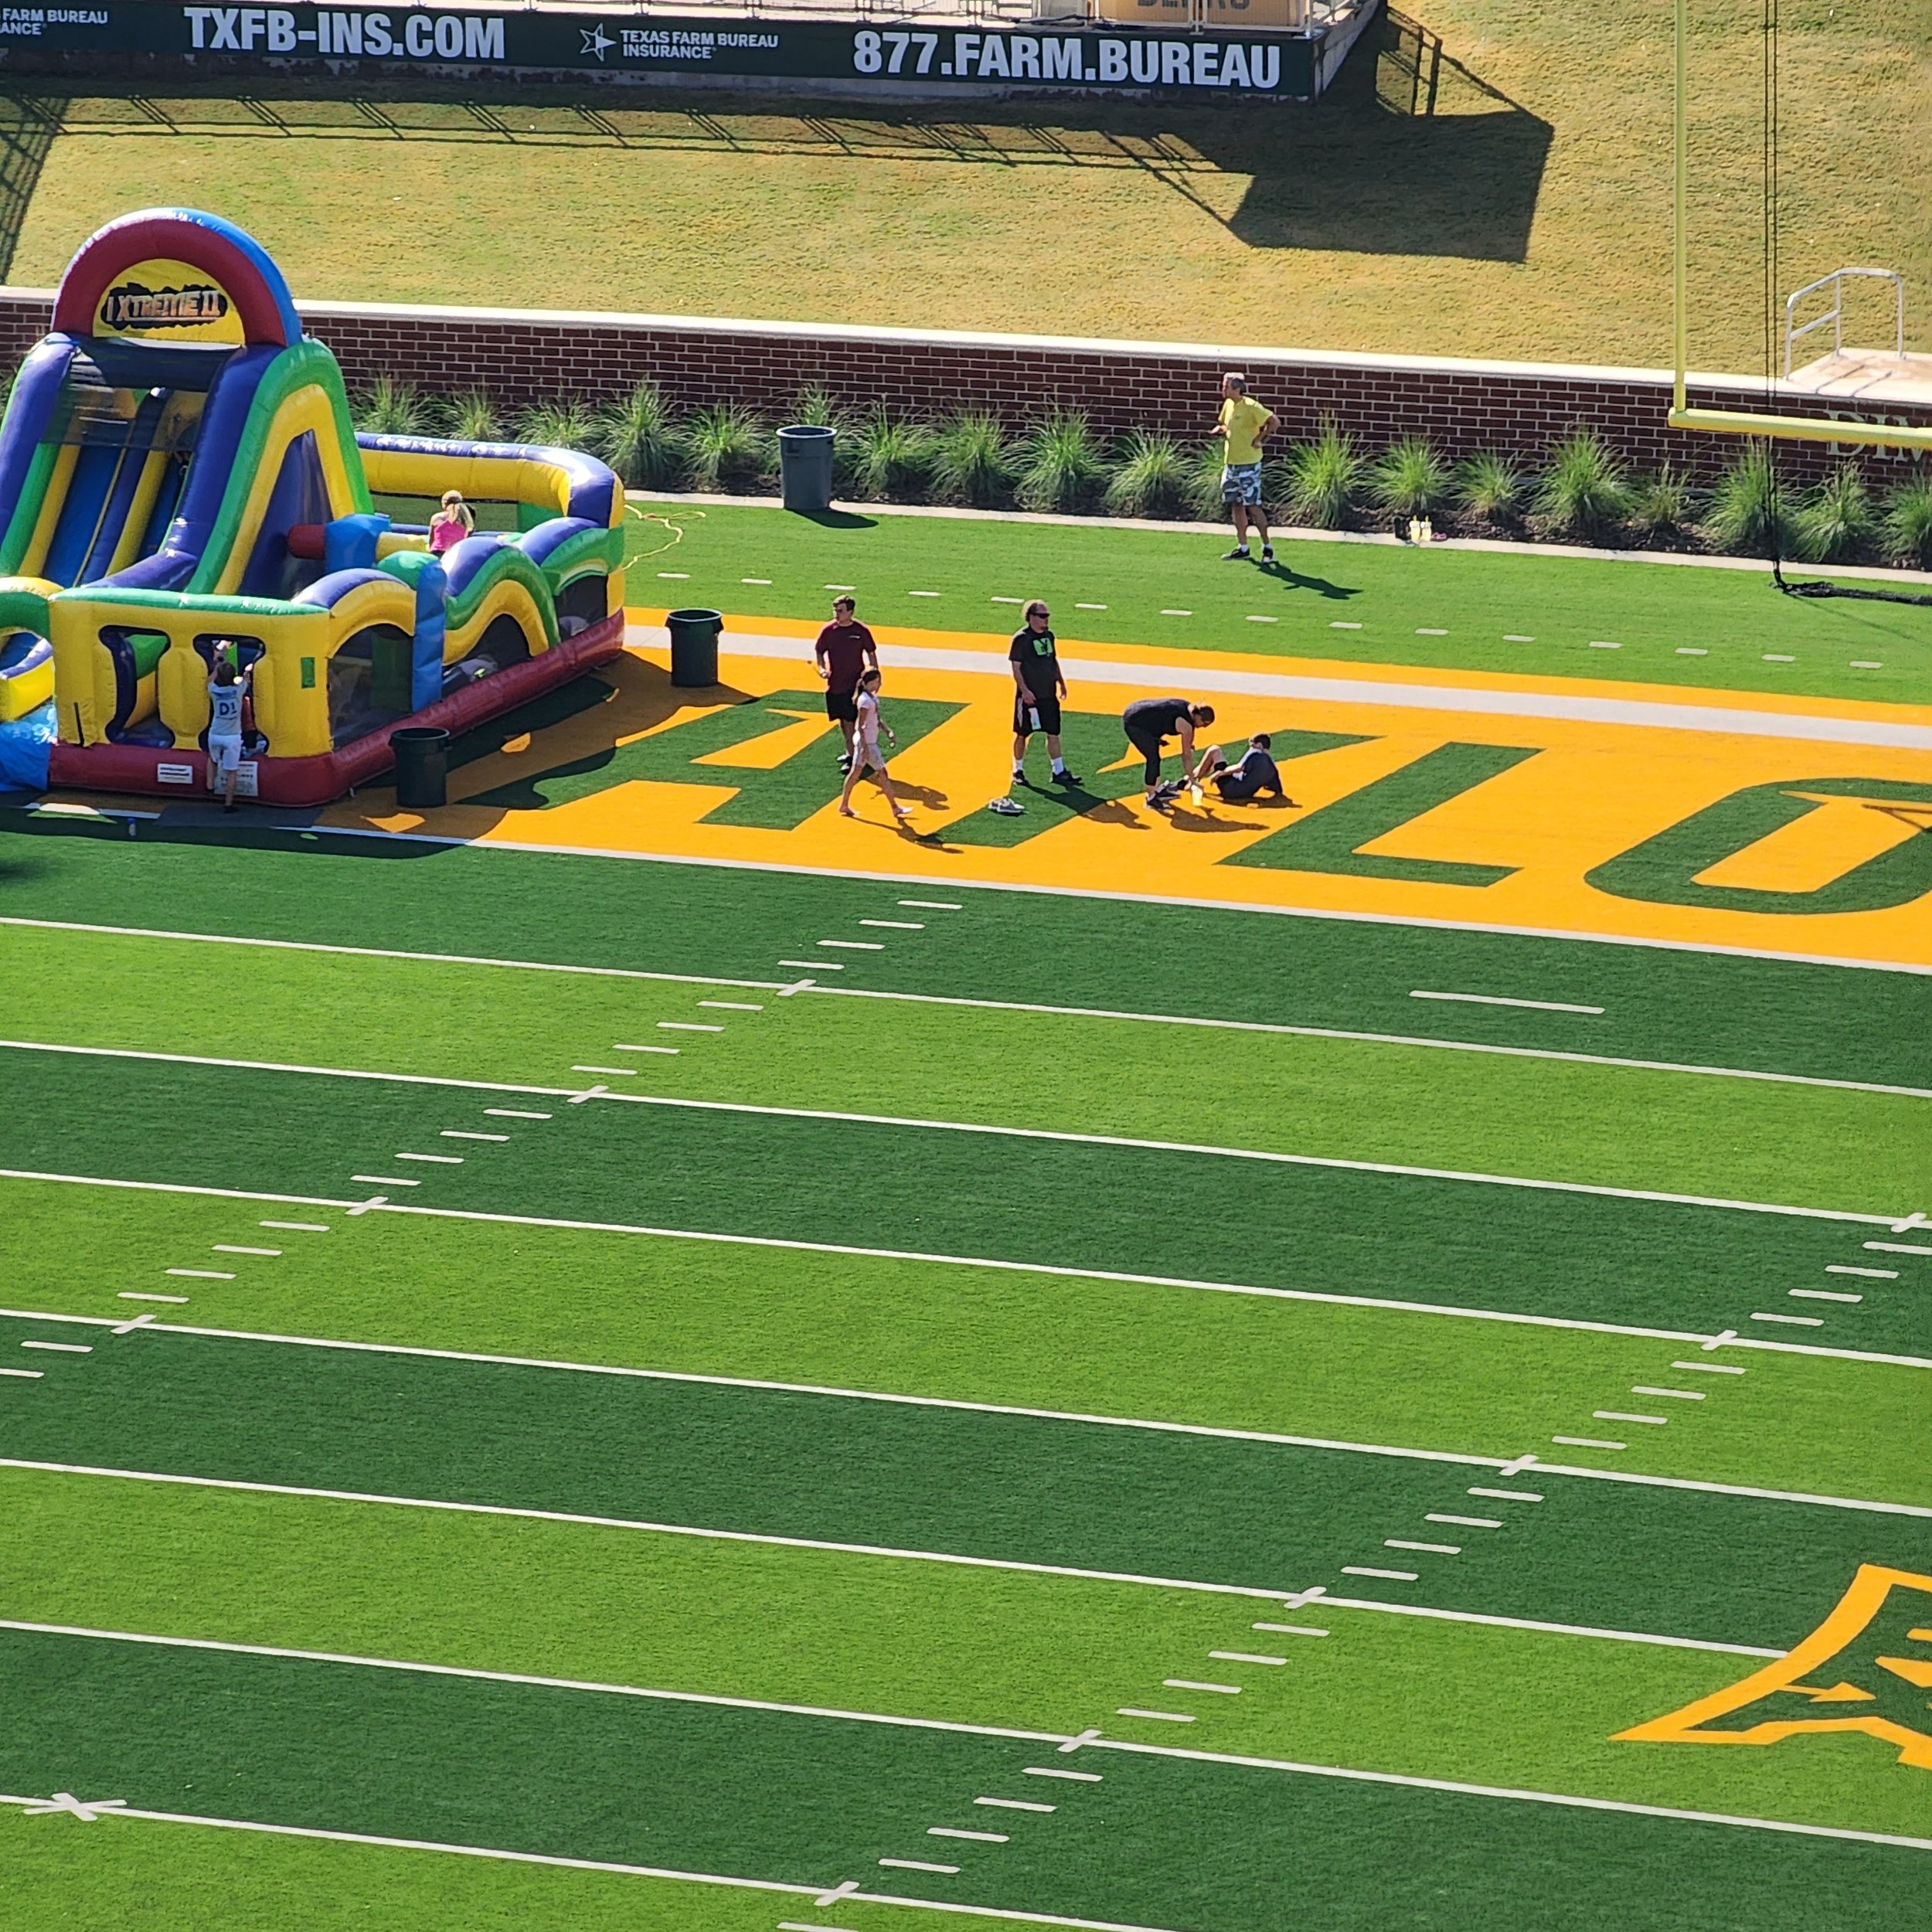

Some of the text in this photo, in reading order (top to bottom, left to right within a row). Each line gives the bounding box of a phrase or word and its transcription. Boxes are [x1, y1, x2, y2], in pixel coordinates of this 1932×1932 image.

[2, 8, 108, 24] FARM BUREAU
[183, 7, 505, 59] TXFB-INS.COM
[619, 29, 779, 48] TEXAS FARM BUREAU
[623, 44, 713, 59] INSURANCE
[852, 30, 1281, 89] 877.FARM.BUREAU
